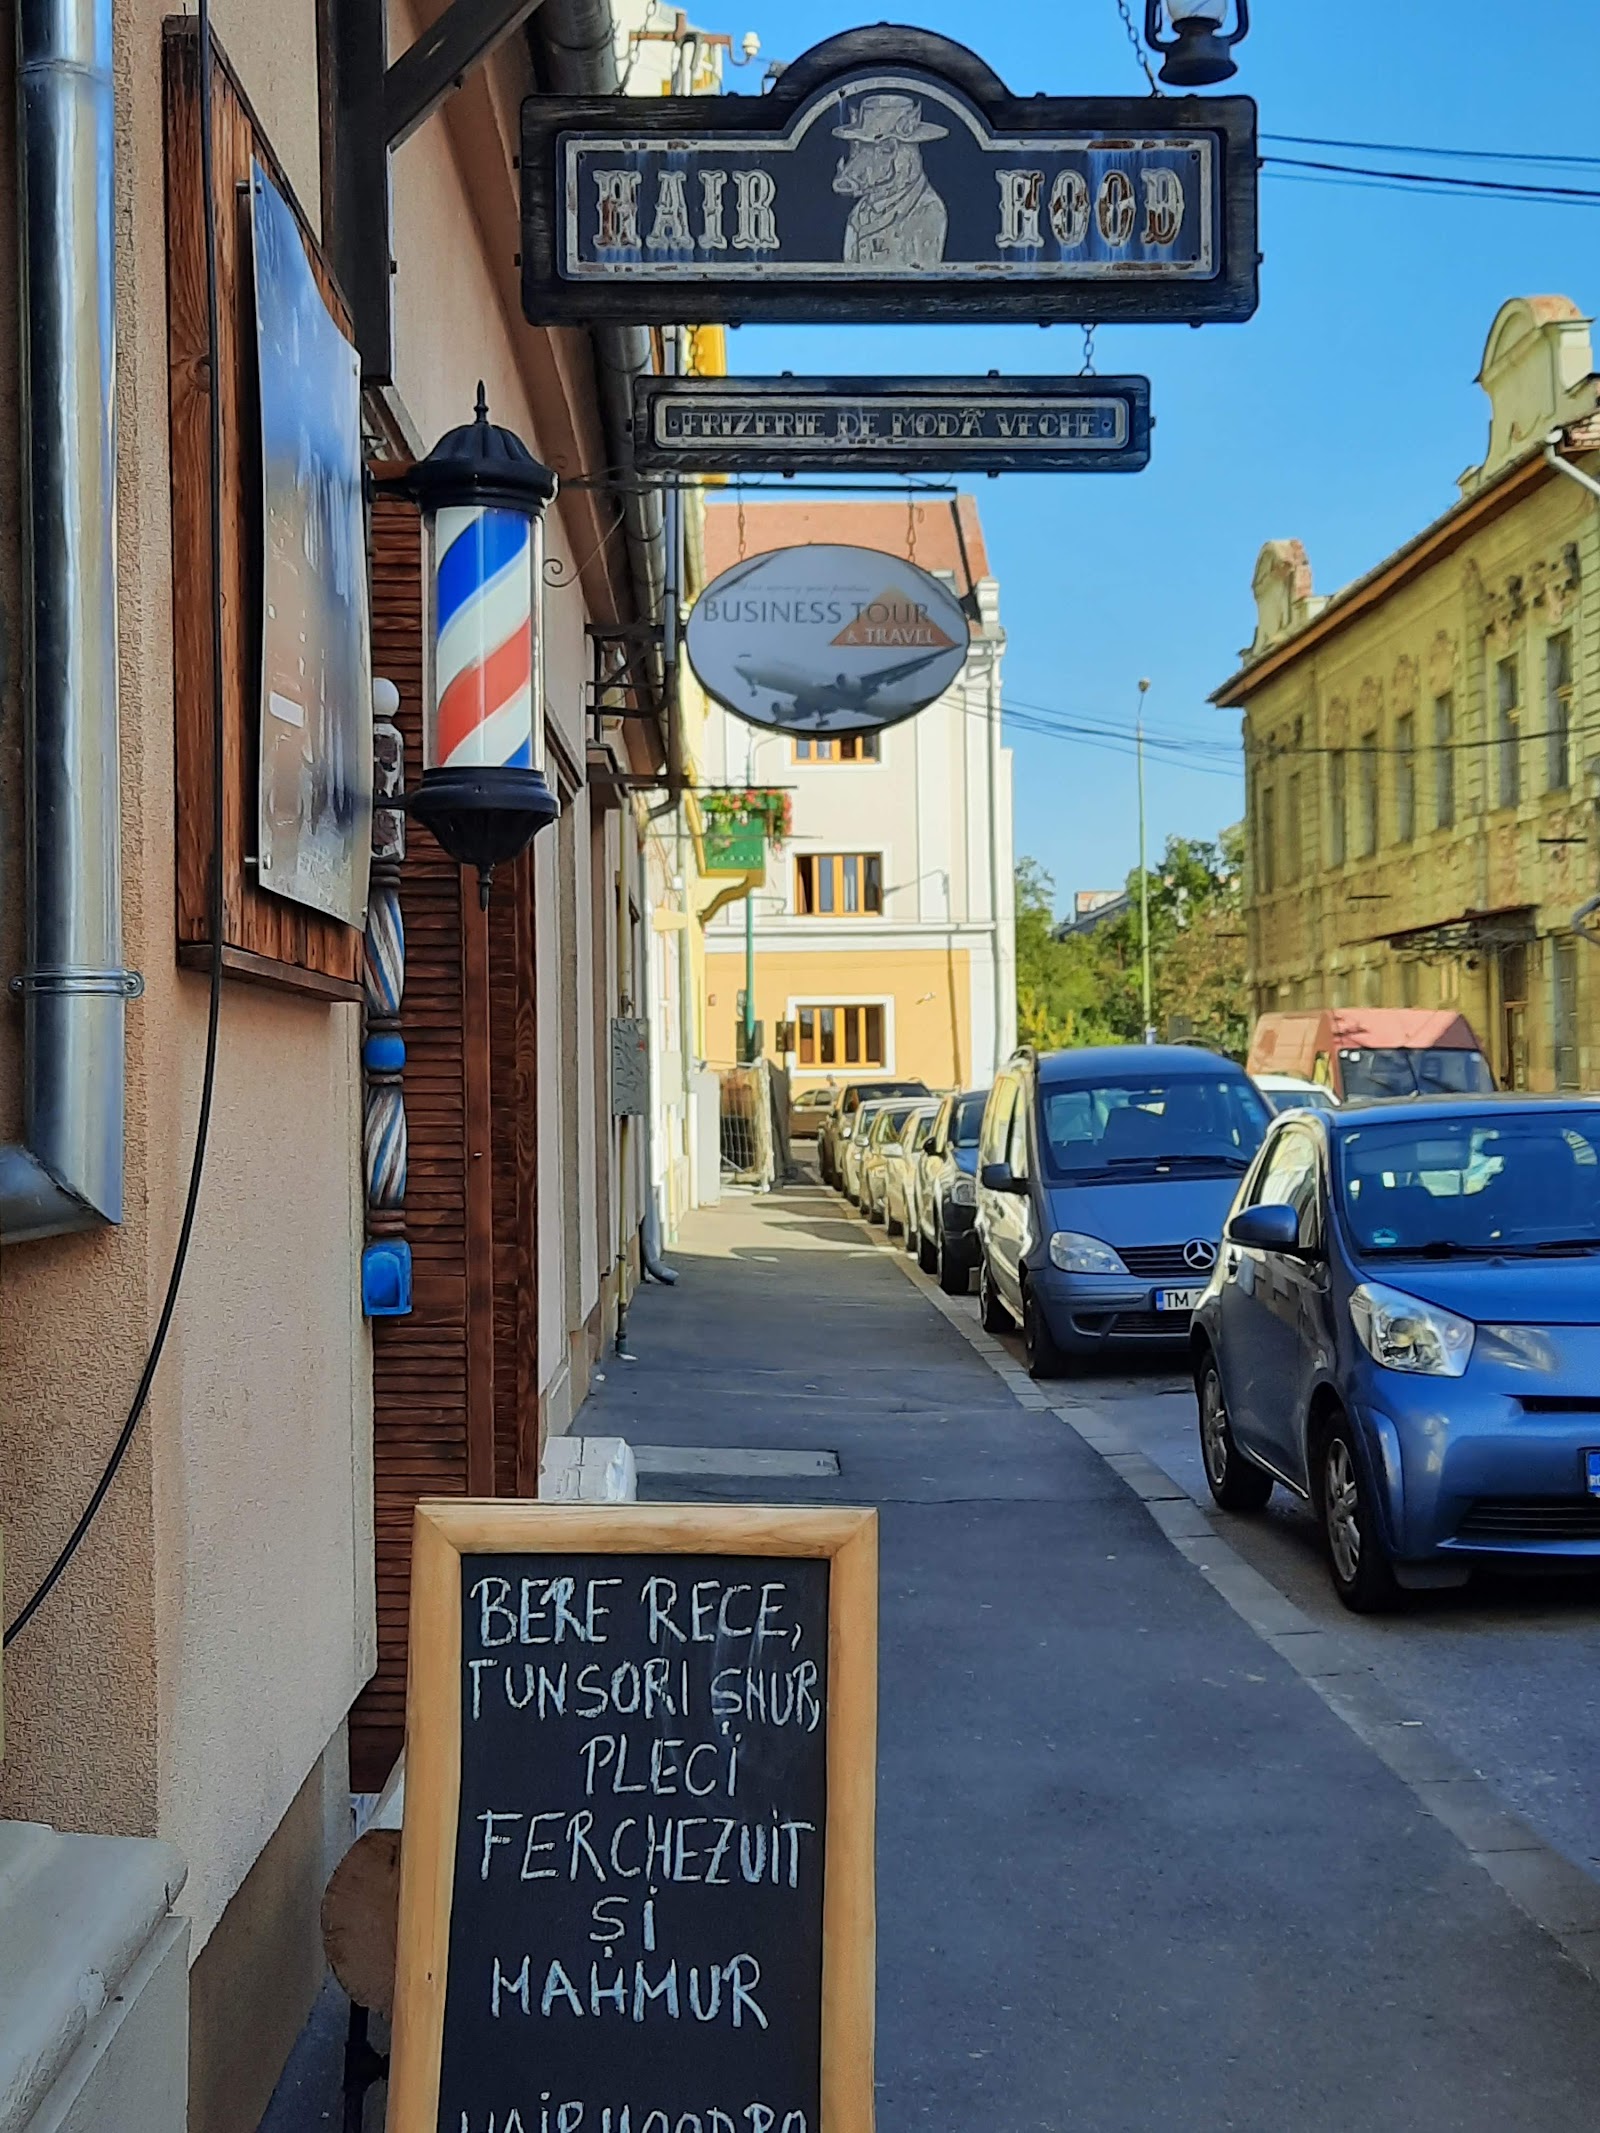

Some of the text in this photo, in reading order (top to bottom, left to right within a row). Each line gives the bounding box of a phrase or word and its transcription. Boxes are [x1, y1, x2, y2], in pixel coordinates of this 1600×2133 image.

[594, 168, 1186, 251] HAIR HOOD
[681, 412, 826, 436] FRIZERIE
[837, 412, 880, 437] DE
[995, 412, 1100, 437] VECHE
[703, 600, 930, 624] BUSINESS TOUR
[865, 628, 934, 643] TRAVEL
[469, 1576, 802, 1651] BERE RECE,
[468, 1658, 689, 1721] TUNSORI
[491, 1953, 769, 2030] MAHMUR
